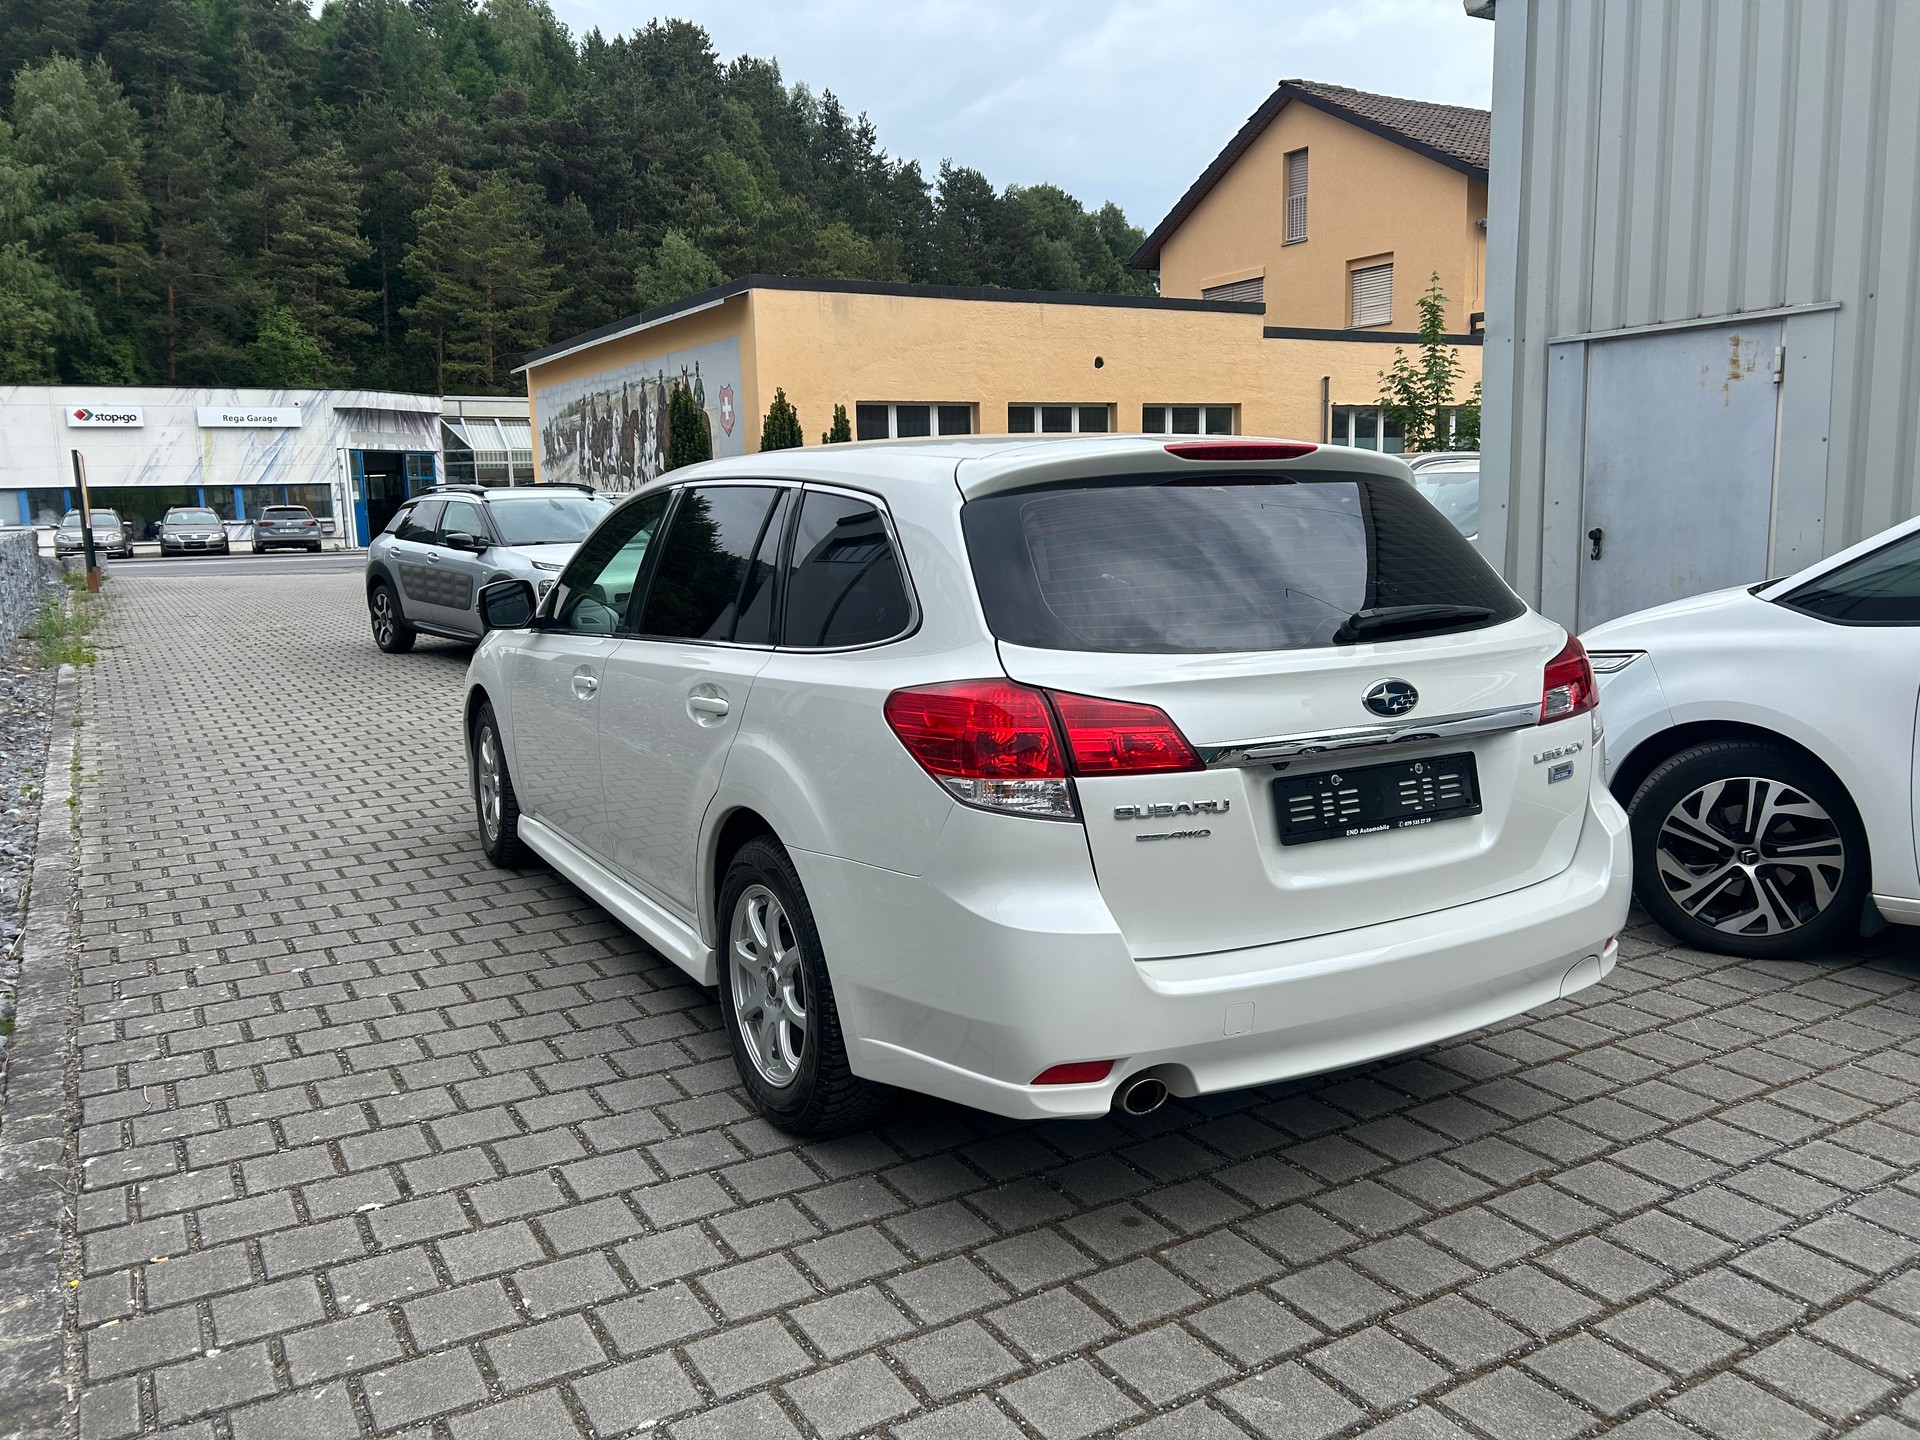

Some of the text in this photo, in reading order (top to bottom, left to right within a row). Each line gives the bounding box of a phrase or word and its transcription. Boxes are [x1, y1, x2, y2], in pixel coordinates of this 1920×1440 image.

[95, 412, 137, 424] stop+go
[222, 414, 278, 424] Rega Garage
[1533, 740, 1585, 765] LEGACY
[1114, 798, 1231, 820] SUBARU
[1346, 828, 1358, 836] END
[1360, 824, 1390, 834] Automobile
